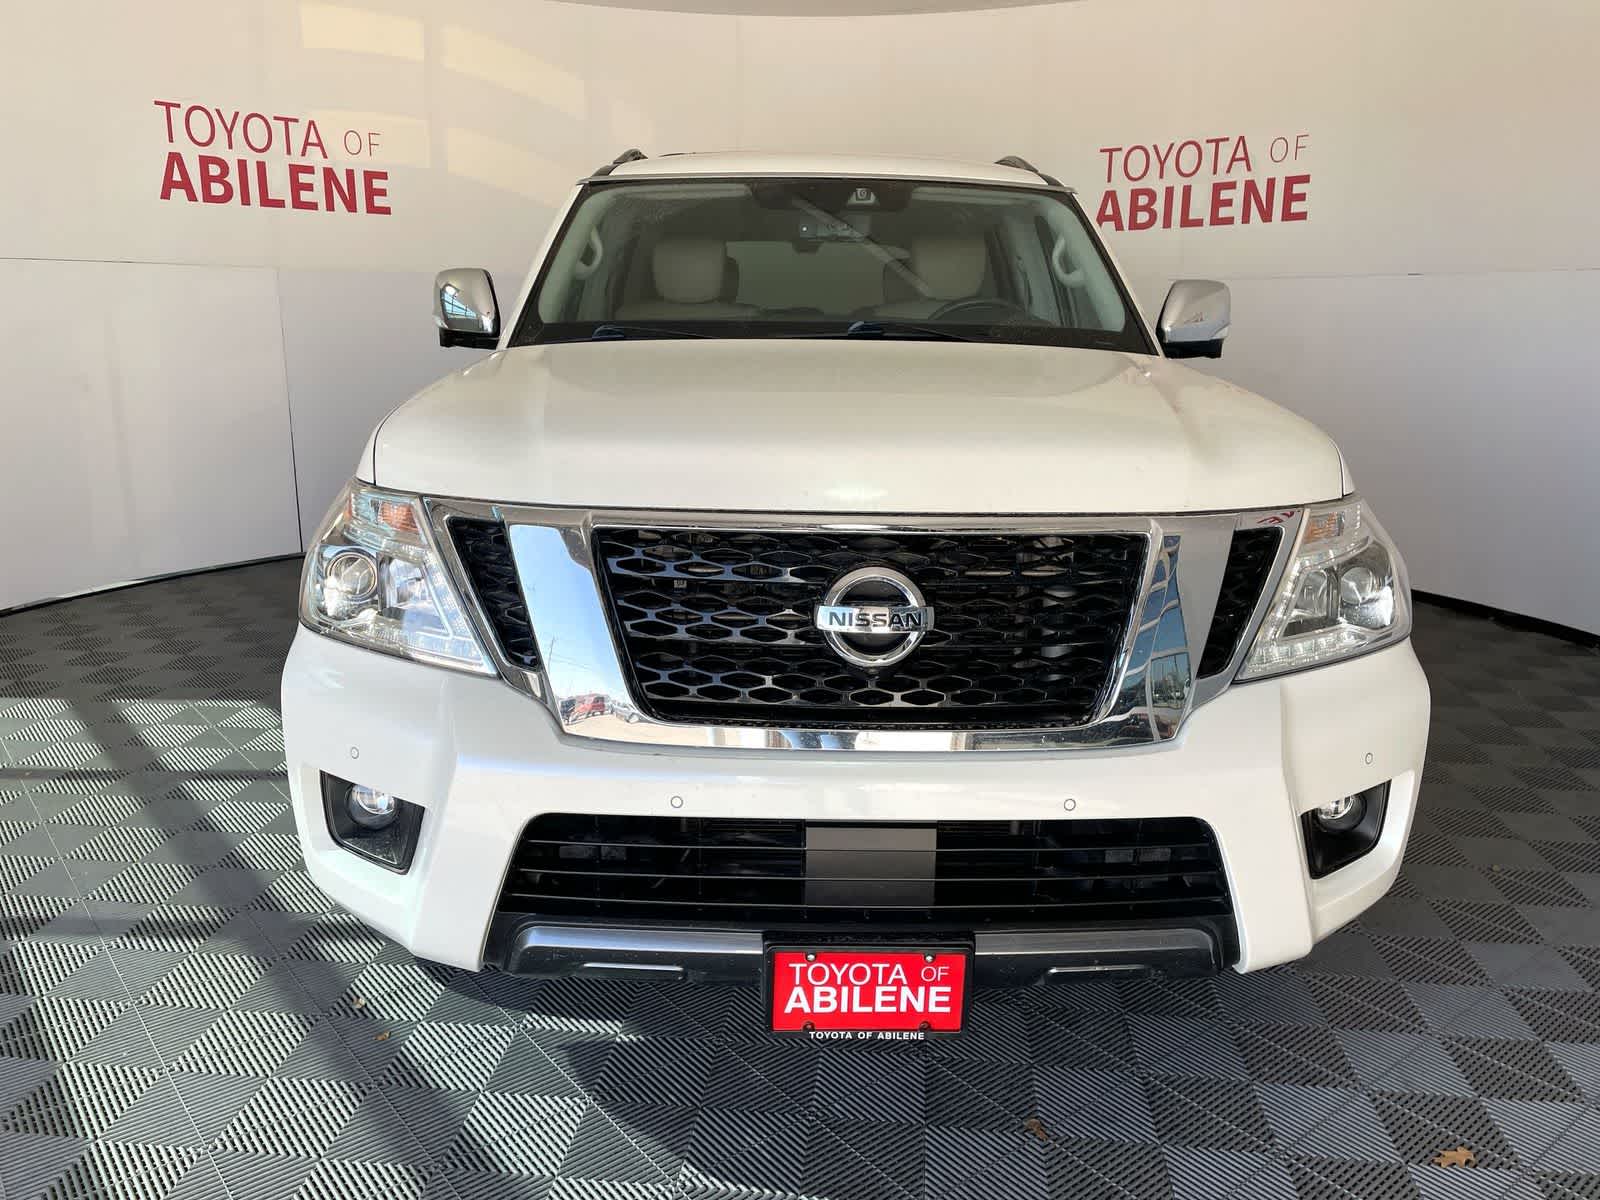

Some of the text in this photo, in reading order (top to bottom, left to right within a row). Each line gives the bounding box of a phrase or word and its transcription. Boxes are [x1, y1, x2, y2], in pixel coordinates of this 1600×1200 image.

[154, 100, 384, 159] TOYOTA OF
[1099, 134, 1309, 183] TOYOTA OF
[160, 151, 392, 215] ABILENE
[1096, 174, 1311, 231] ABILENE
[828, 611, 922, 628] NISSAN
[789, 963, 949, 986] TOYOTA OF
[784, 986, 951, 1013] ABILENE
[809, 1031, 925, 1040] TOYOTA OF ABILENE
